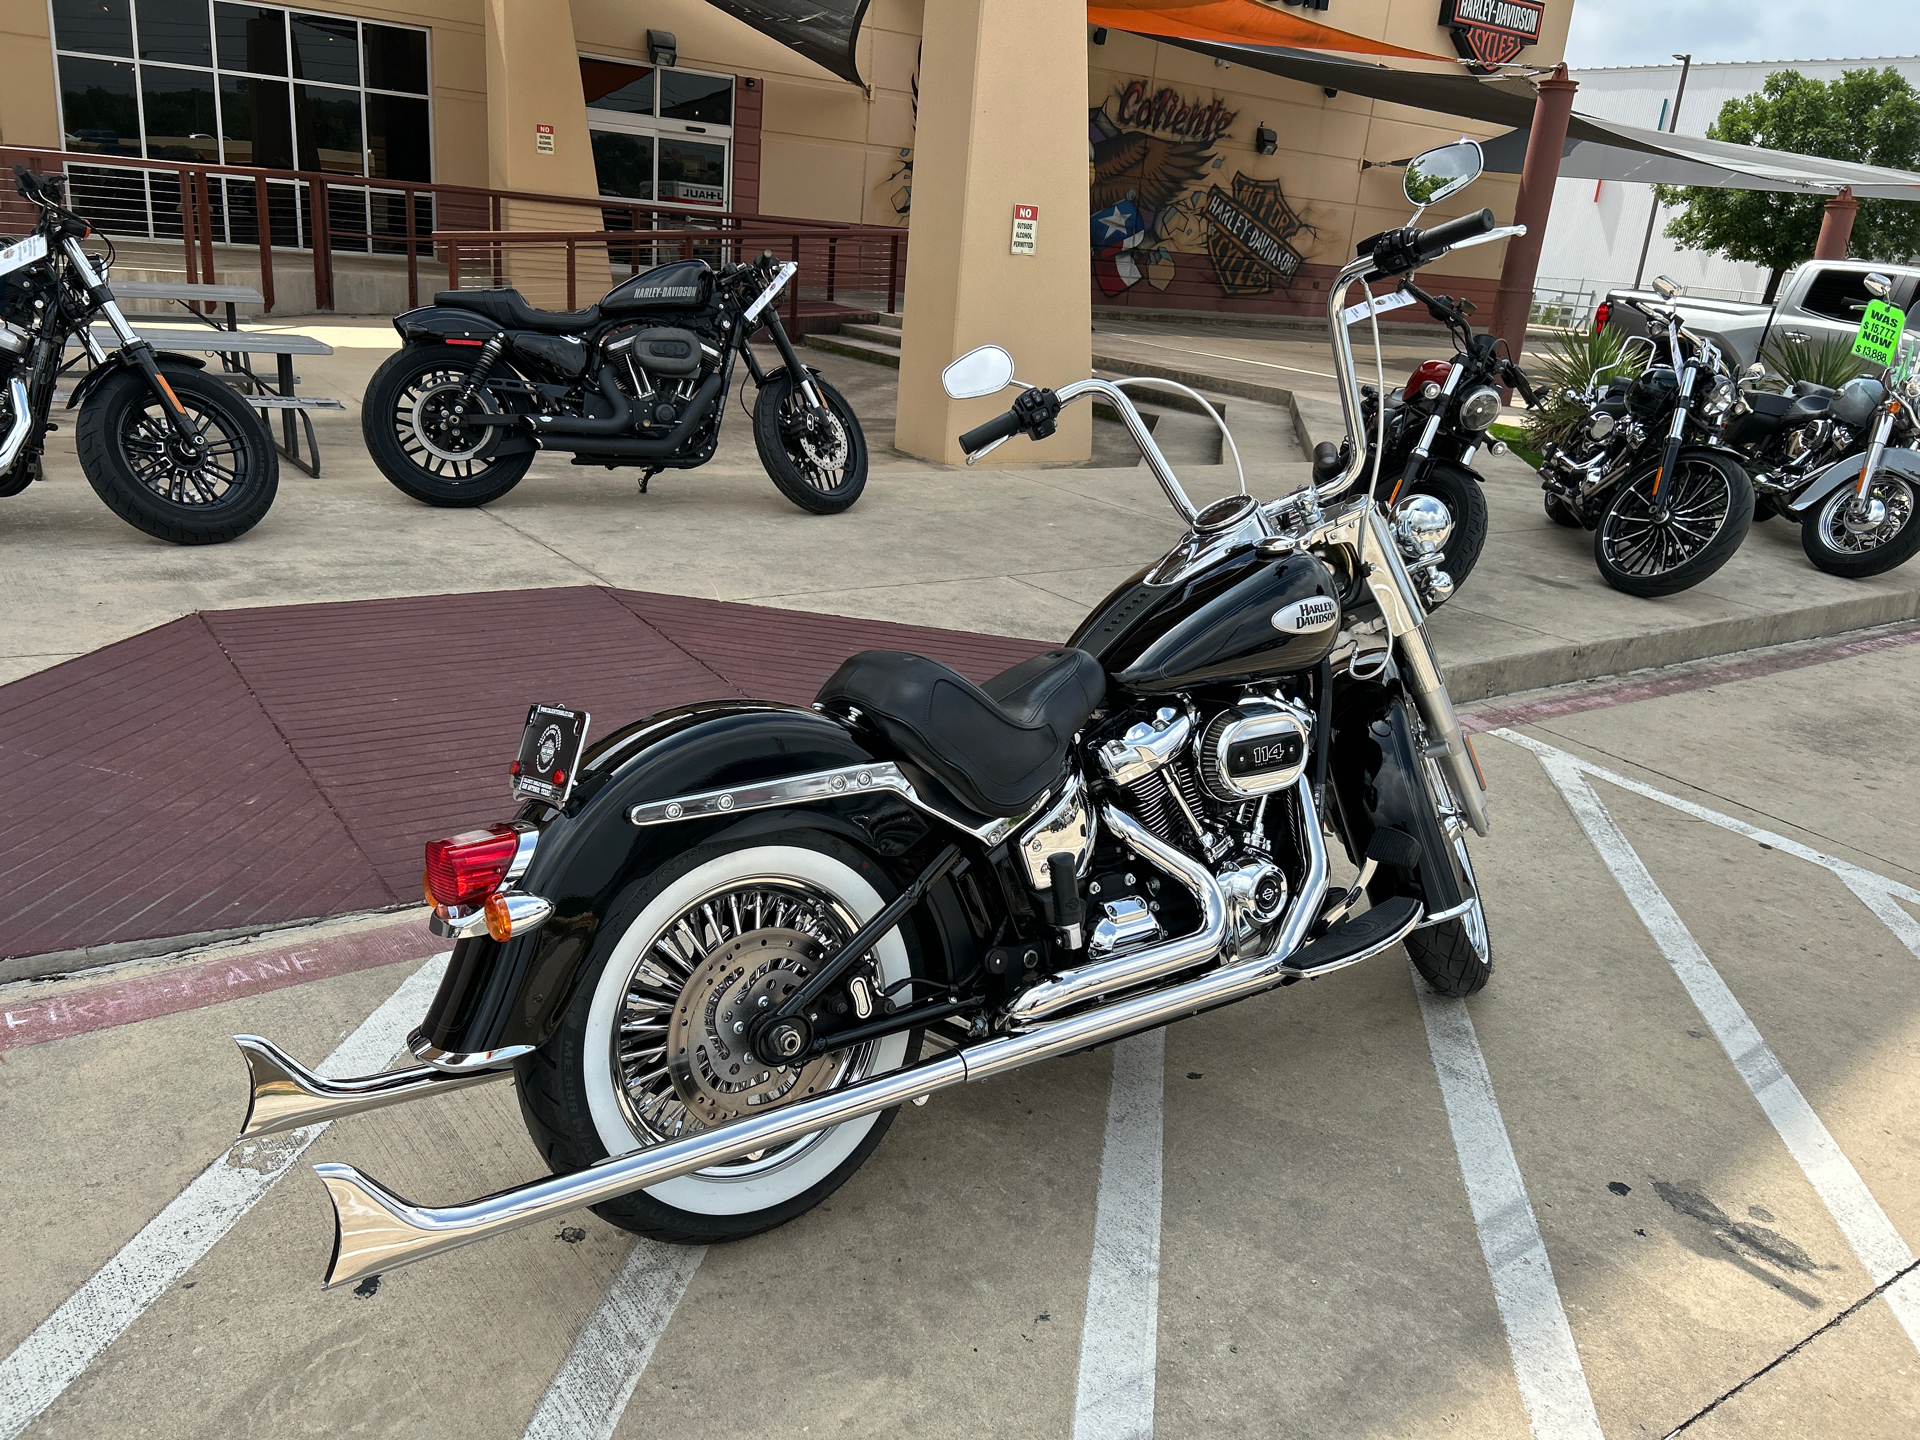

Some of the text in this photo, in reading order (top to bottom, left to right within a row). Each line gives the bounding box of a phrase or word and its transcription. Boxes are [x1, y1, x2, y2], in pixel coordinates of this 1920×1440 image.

[1459, 0, 1539, 33] HARLEY-DAVIDSON
[1474, 28, 1515, 62] CYCLES
[1118, 80, 1239, 138] Caliente
[1443, 183, 1455, 192] CPO
[1019, 207, 1032, 218] NO
[1240, 184, 1290, 236] MOTOR
[1017, 222, 1033, 230] OUTSIDE
[1208, 195, 1297, 275] HARLEY-DAVIDSON
[1013, 240, 1034, 249] PERMITTED
[633, 286, 698, 299] HARLEY-DAVIDSON
[1870, 309, 1899, 328] WAS
[1862, 330, 1893, 349] NOW
[1295, 611, 1337, 630] DAVIDSON
[1253, 743, 1285, 764] 114
[563, 1039, 574, 1072] ME
[647, 1206, 711, 1233] ULTRA
